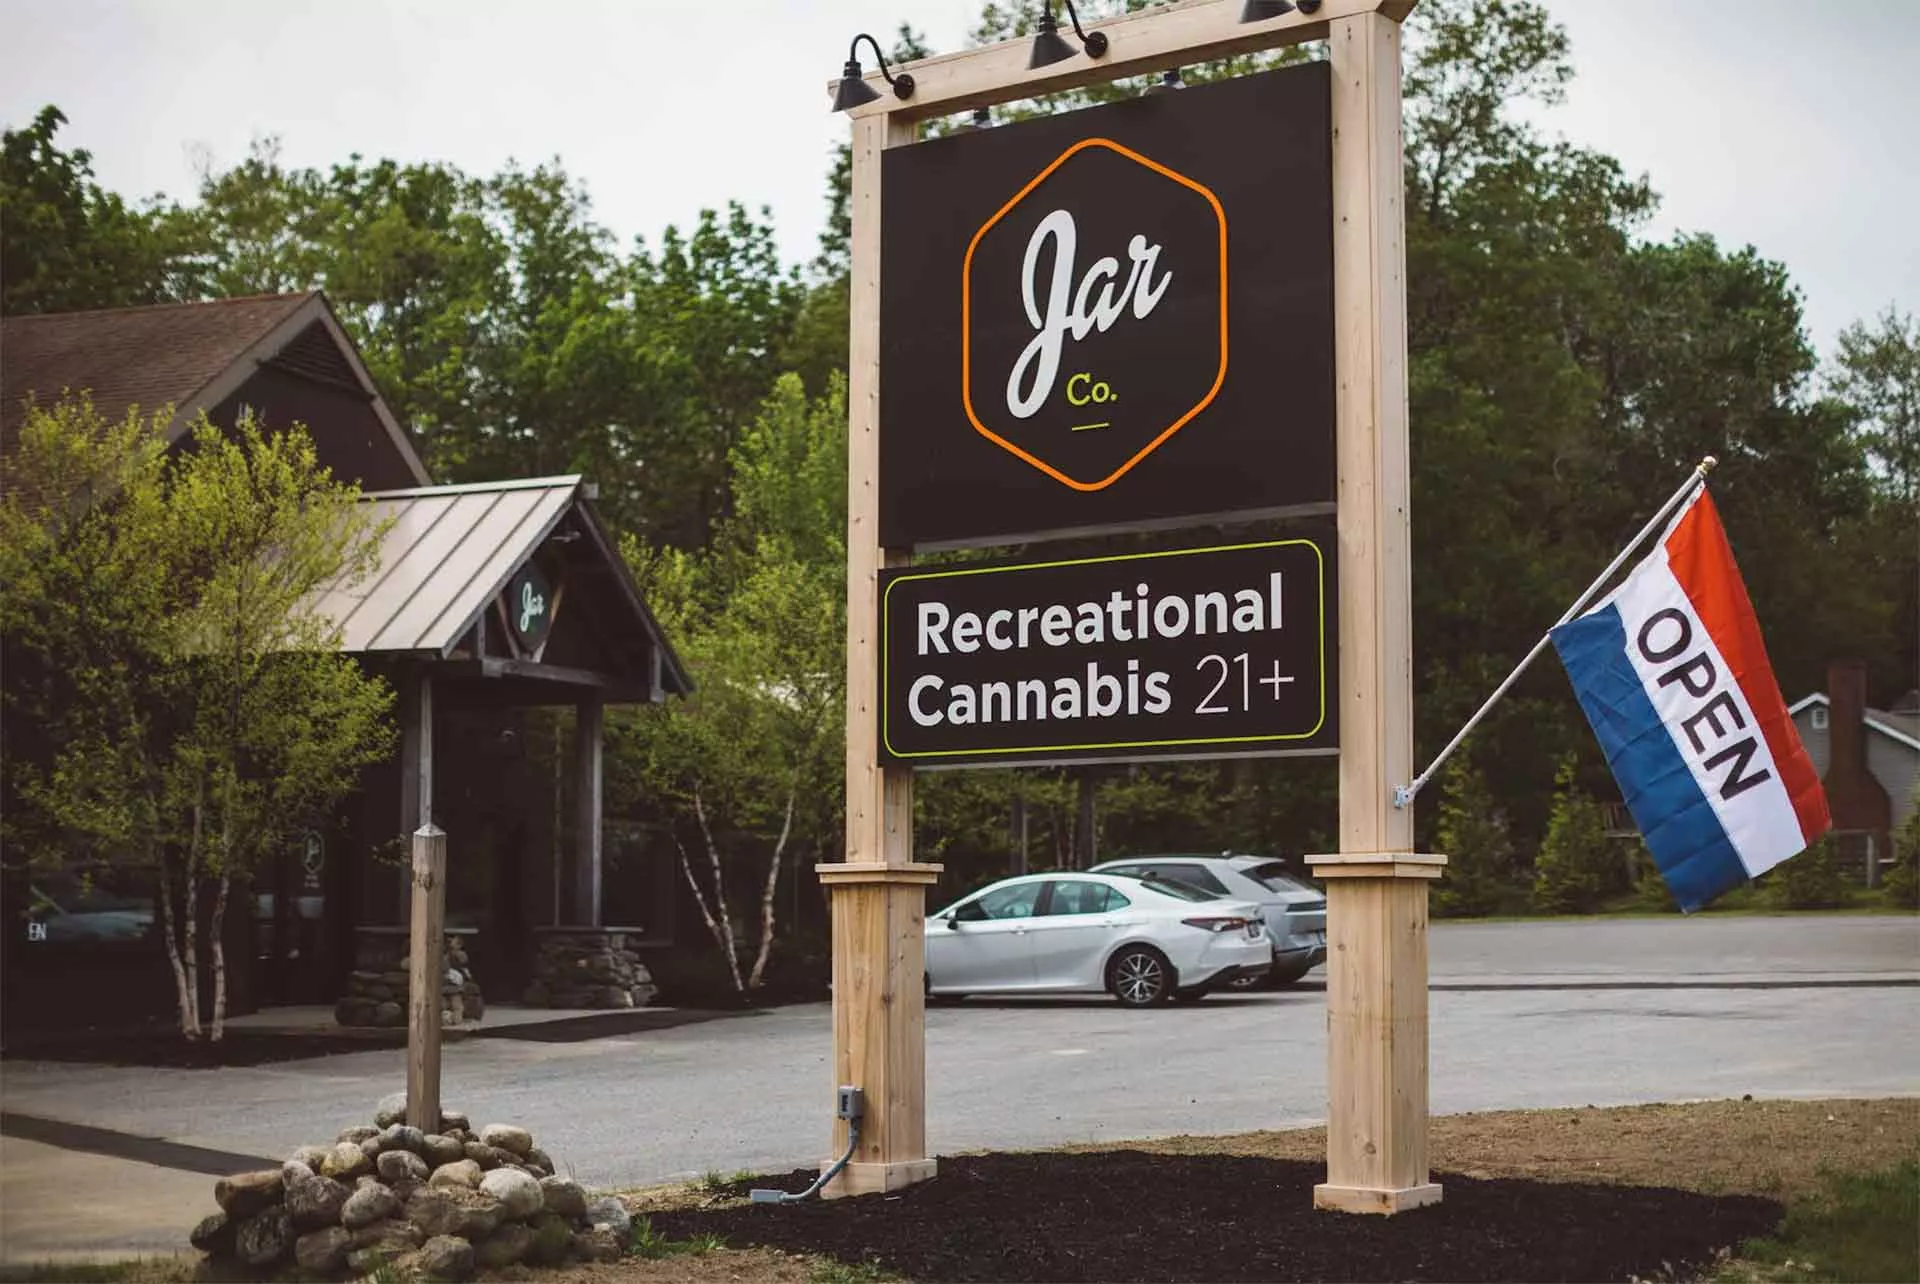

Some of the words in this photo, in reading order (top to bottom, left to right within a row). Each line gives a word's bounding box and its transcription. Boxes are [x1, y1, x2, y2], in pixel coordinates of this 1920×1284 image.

[1007, 209, 1172, 418] Jar
[1066, 373, 1118, 407] Co.
[917, 572, 1283, 655] Recreational
[908, 659, 1171, 727] Cannabis
[1194, 652, 1295, 714] 21+
[1637, 607, 1771, 801] OPEN
